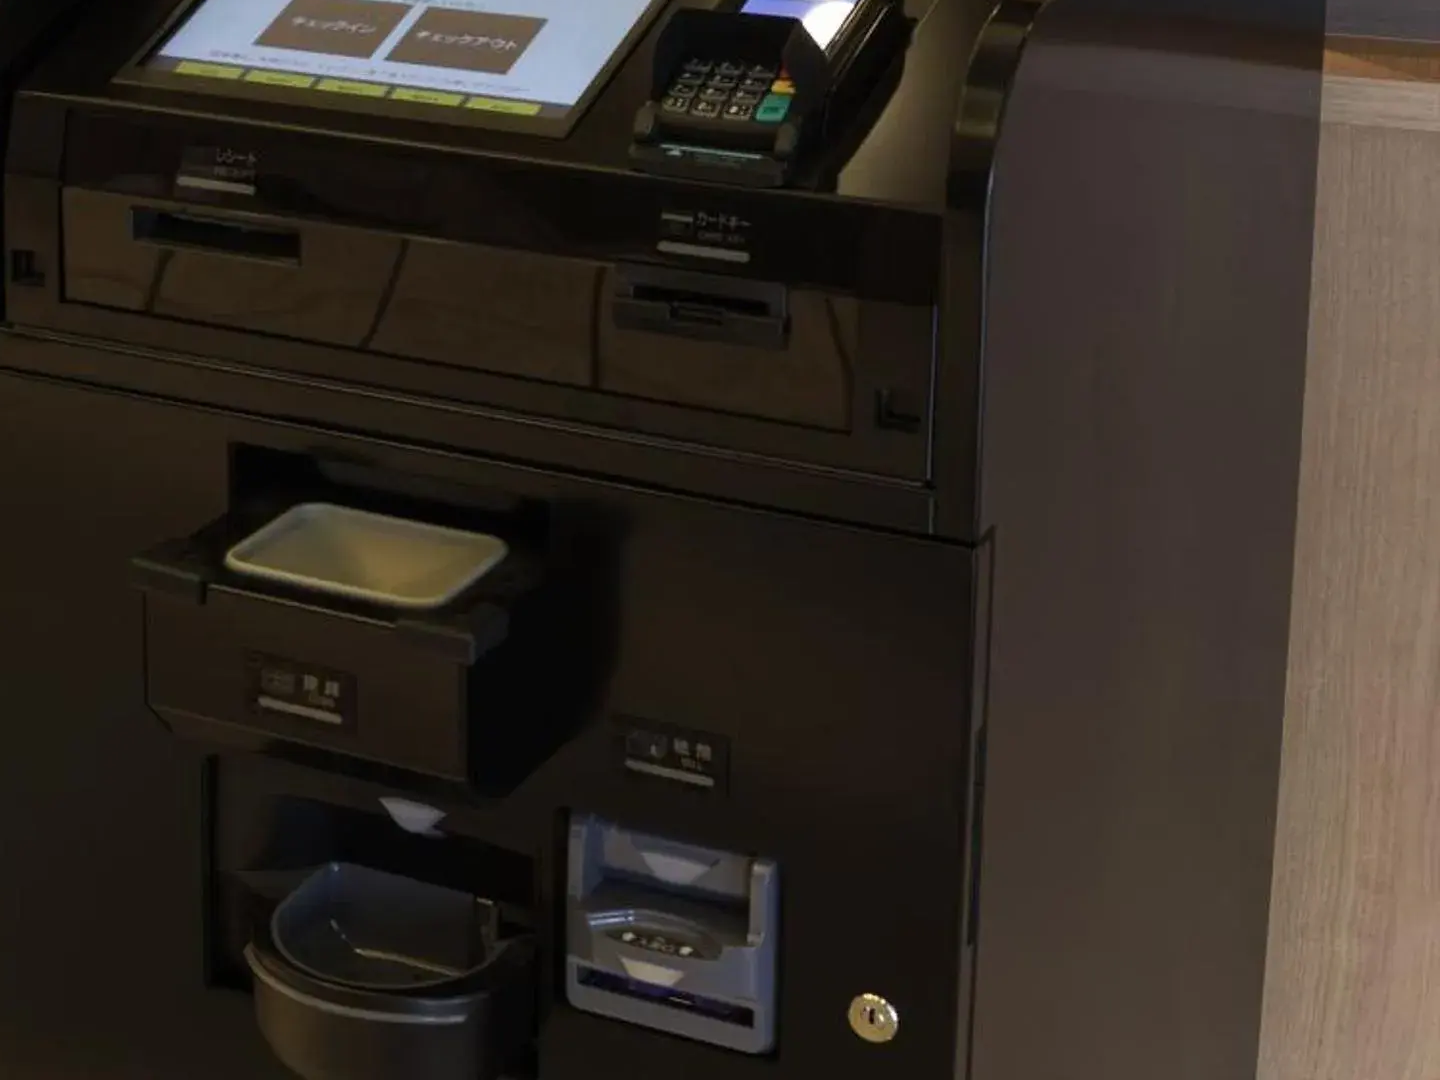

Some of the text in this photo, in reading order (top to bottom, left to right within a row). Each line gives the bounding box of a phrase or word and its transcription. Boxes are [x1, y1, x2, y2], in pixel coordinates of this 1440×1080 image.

[292, 16, 376, 35] チェックイン
[416, 30, 516, 52] チェックアウト
